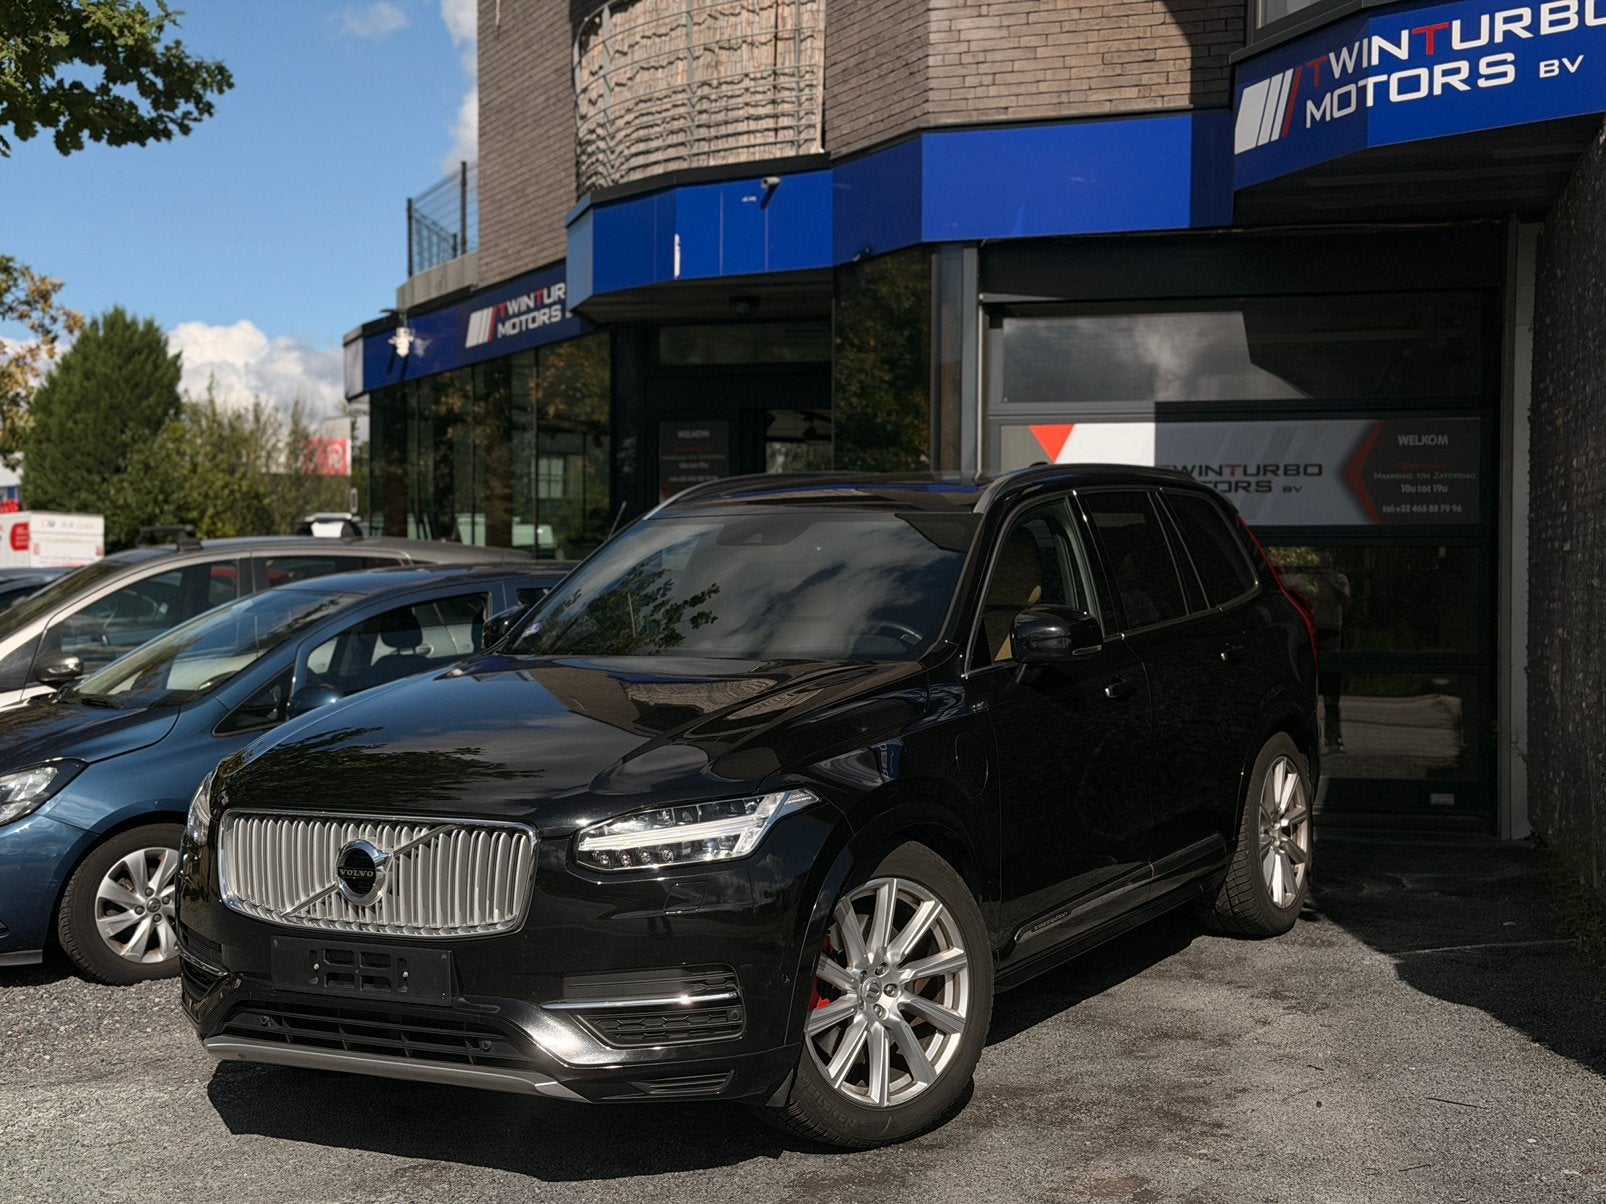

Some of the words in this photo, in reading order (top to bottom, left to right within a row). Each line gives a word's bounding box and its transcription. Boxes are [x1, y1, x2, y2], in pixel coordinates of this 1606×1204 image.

[1305, 52, 1516, 129] MOTORS
[1538, 54, 1585, 79] BV
[498, 282, 566, 319] TWINTUR
[497, 304, 562, 339] MOTORS
[1397, 434, 1449, 446] WELKOM
[1156, 463, 1323, 478] WINTURBO
[1282, 485, 1303, 494] BV
[1400, 483, 1416, 493] 10u
[1417, 483, 1431, 493] tot
[1432, 483, 1448, 493] 19u
[339, 868, 374, 878] VOLVO
